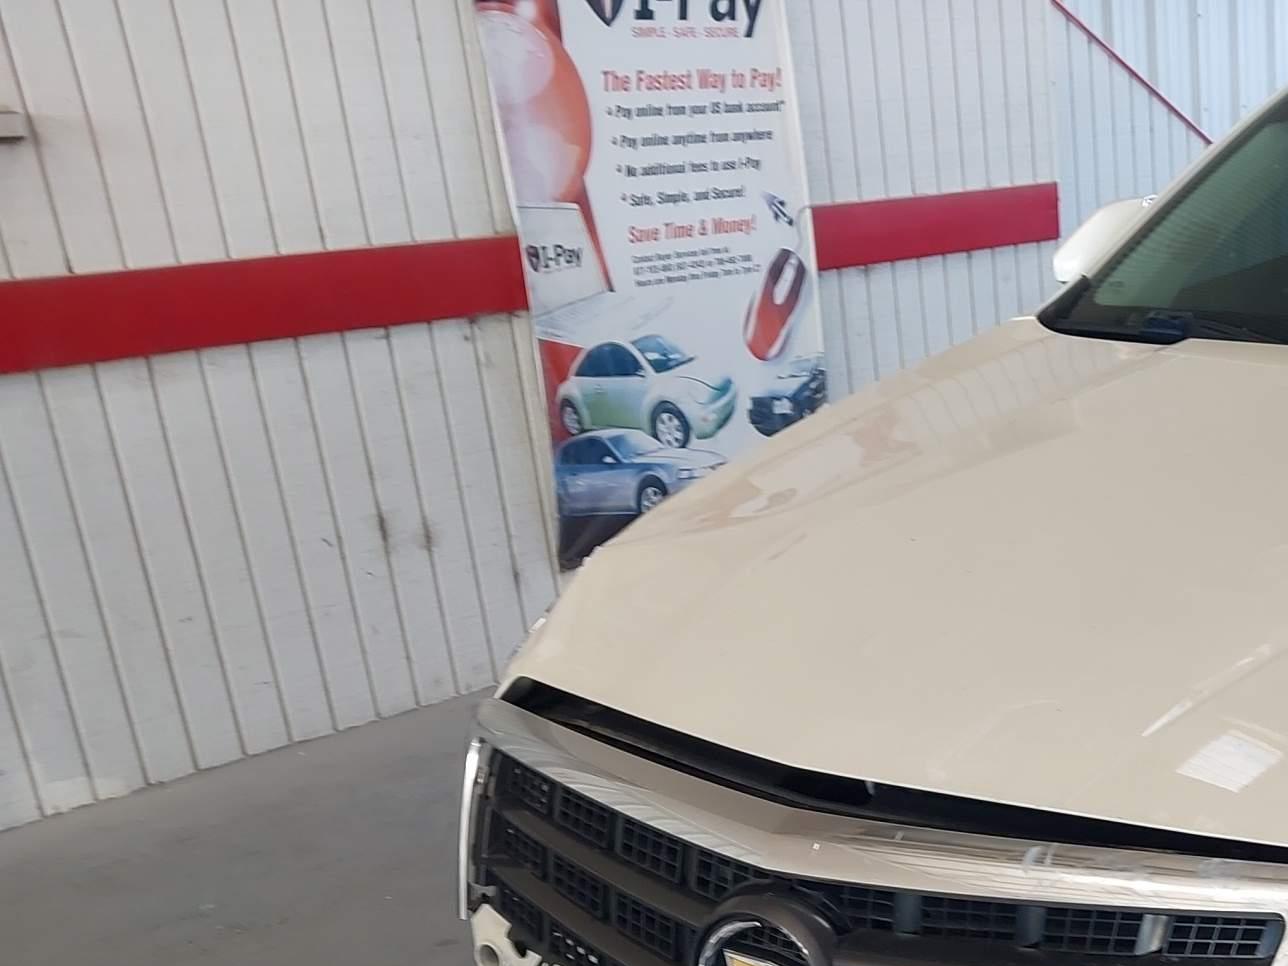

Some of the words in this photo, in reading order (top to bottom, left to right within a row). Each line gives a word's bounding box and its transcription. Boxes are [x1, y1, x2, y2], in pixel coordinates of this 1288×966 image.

[602, 69, 631, 92] The
[636, 69, 692, 91] Fastest
[697, 68, 726, 93] Way
[732, 69, 746, 89] to
[750, 67, 782, 92] Pay!
[615, 104, 633, 120] Pay
[620, 134, 638, 150] Pay
[628, 225, 659, 244] Save
[663, 221, 695, 240] Time
[698, 219, 707, 236] &
[711, 214, 757, 236] Money!
[541, 244, 582, 269] I-Pay
